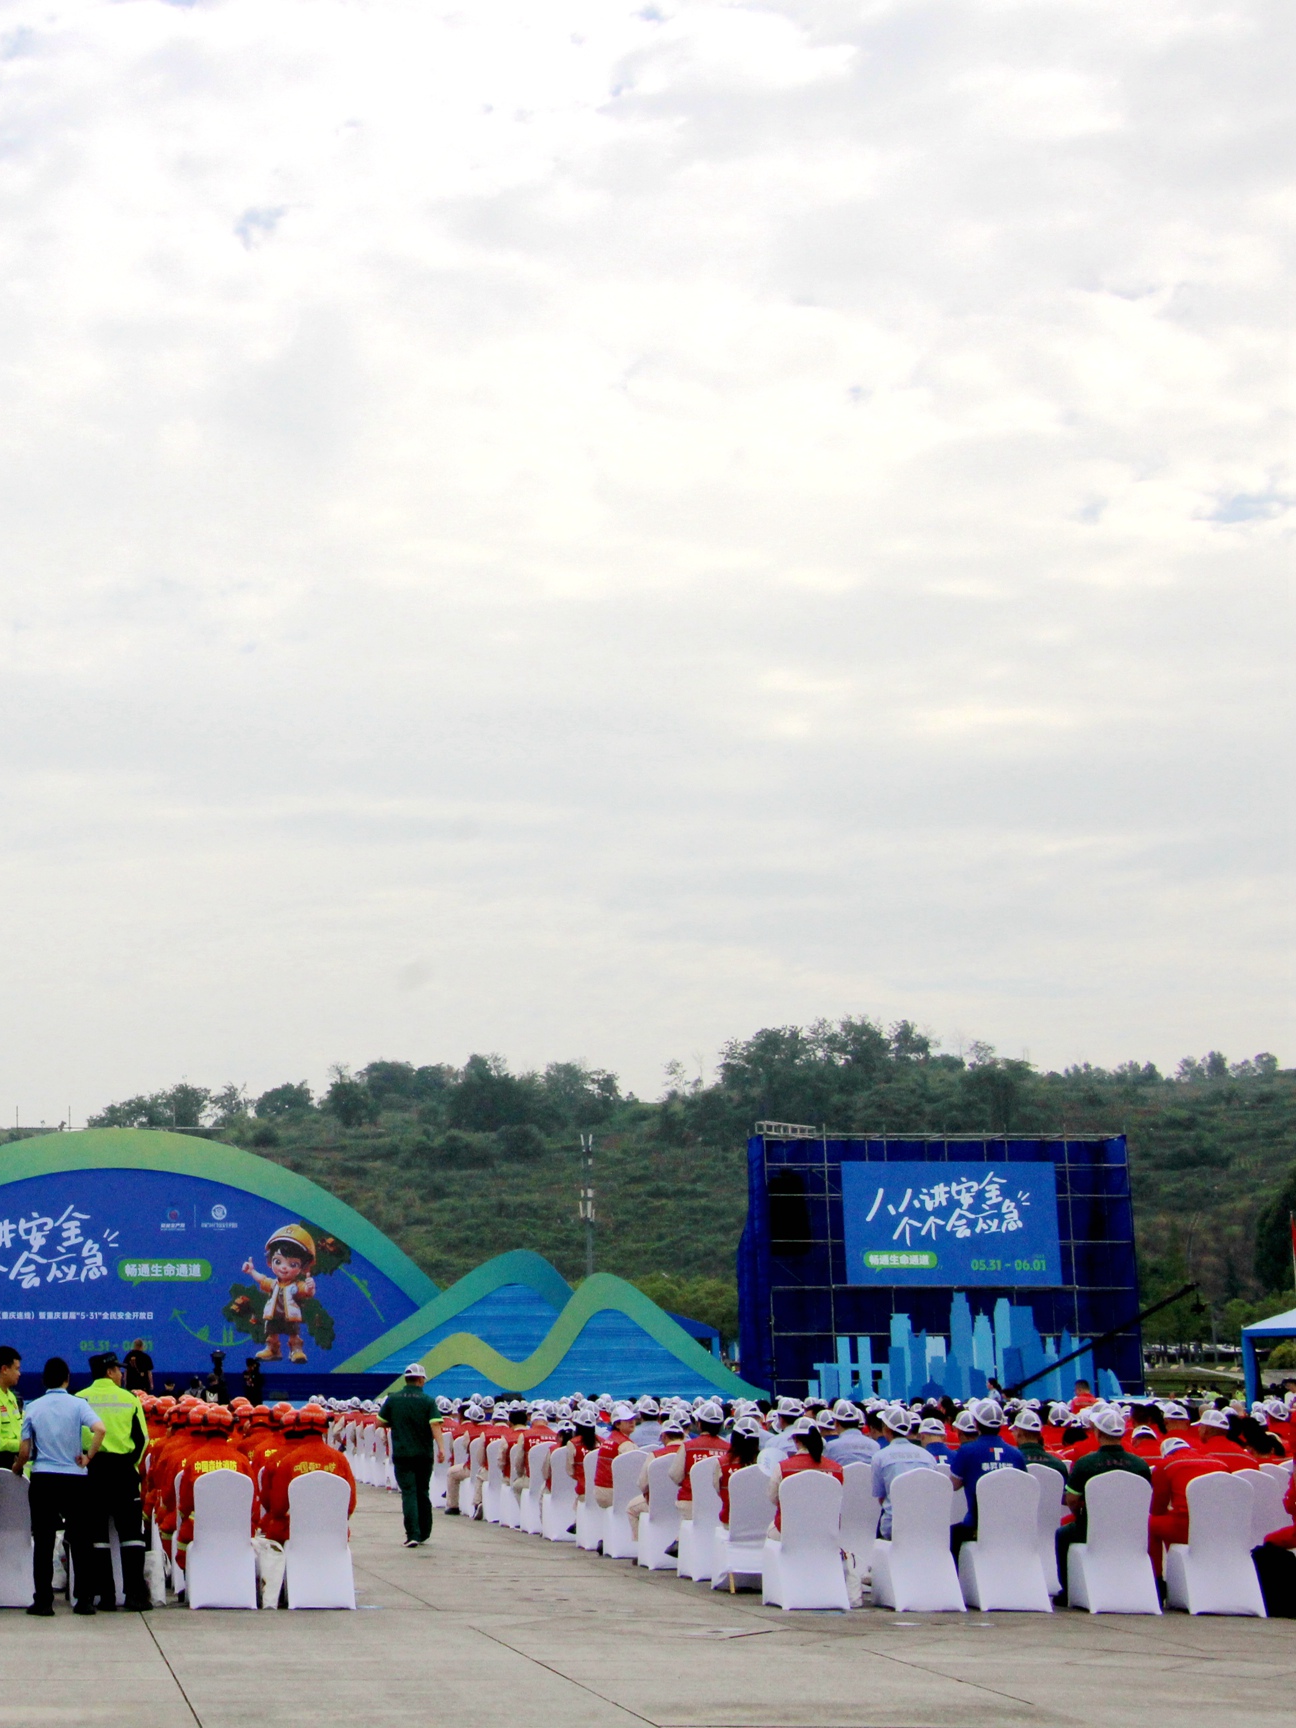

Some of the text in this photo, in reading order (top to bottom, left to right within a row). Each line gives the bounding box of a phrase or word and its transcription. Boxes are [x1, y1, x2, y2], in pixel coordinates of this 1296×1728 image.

[865, 1170, 1008, 1222] 人人讲安全
[892, 1198, 1024, 1247] 个个会应急
[124, 1263, 202, 1278] 畅通生命通道
[868, 1254, 930, 1266] 畅通生命通道
